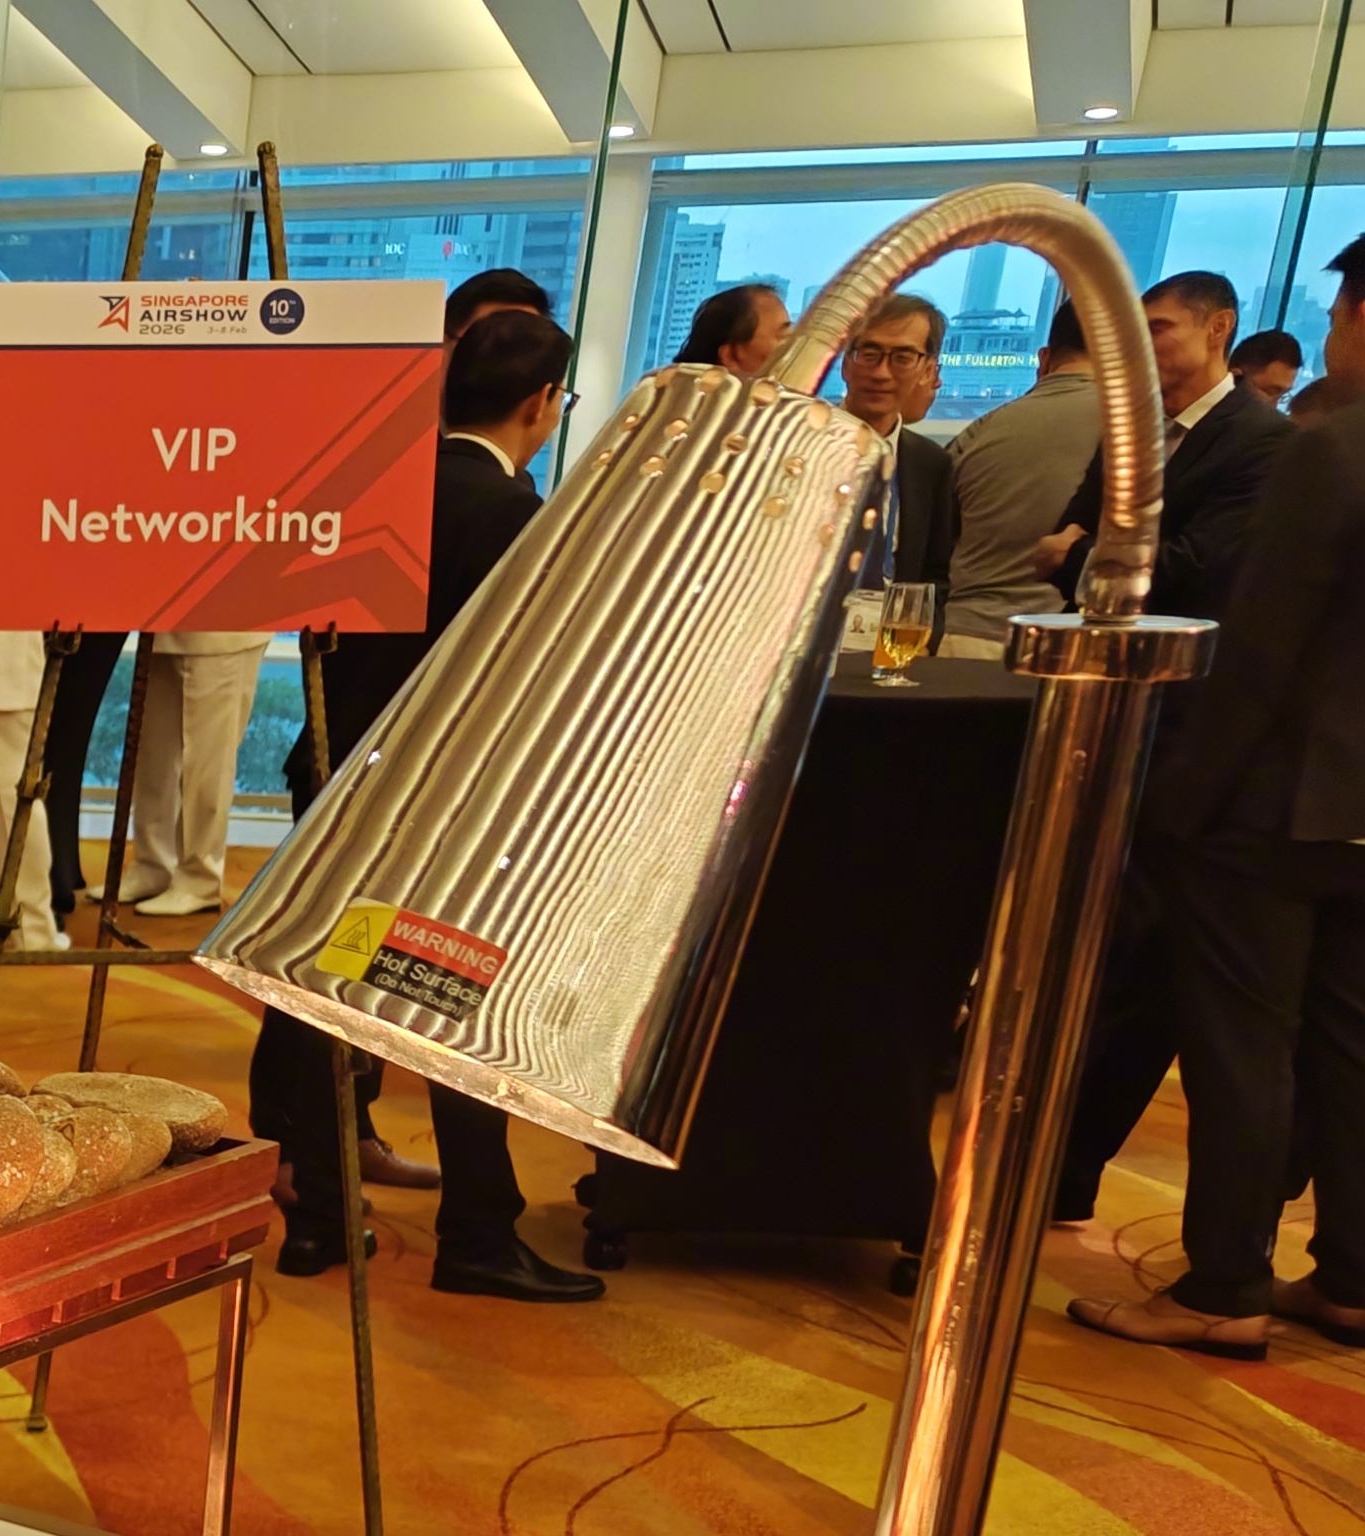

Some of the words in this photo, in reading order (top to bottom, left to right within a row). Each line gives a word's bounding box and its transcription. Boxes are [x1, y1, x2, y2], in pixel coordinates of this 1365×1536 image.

[140, 295, 249, 307] SINGAPORE
[139, 309, 248, 322] AIRSHOW
[139, 324, 185, 335] 2026
[229, 325, 247, 334] Feb
[942, 354, 962, 366] THE
[965, 354, 1024, 367] FULLERTON
[152, 428, 236, 472] VIP
[41, 495, 342, 556] Networking
[392, 919, 499, 975] WARNING
[373, 949, 405, 975] Hot
[409, 963, 482, 1006] Surface
[374, 973, 398, 988] (Do
[399, 980, 421, 998] Not
